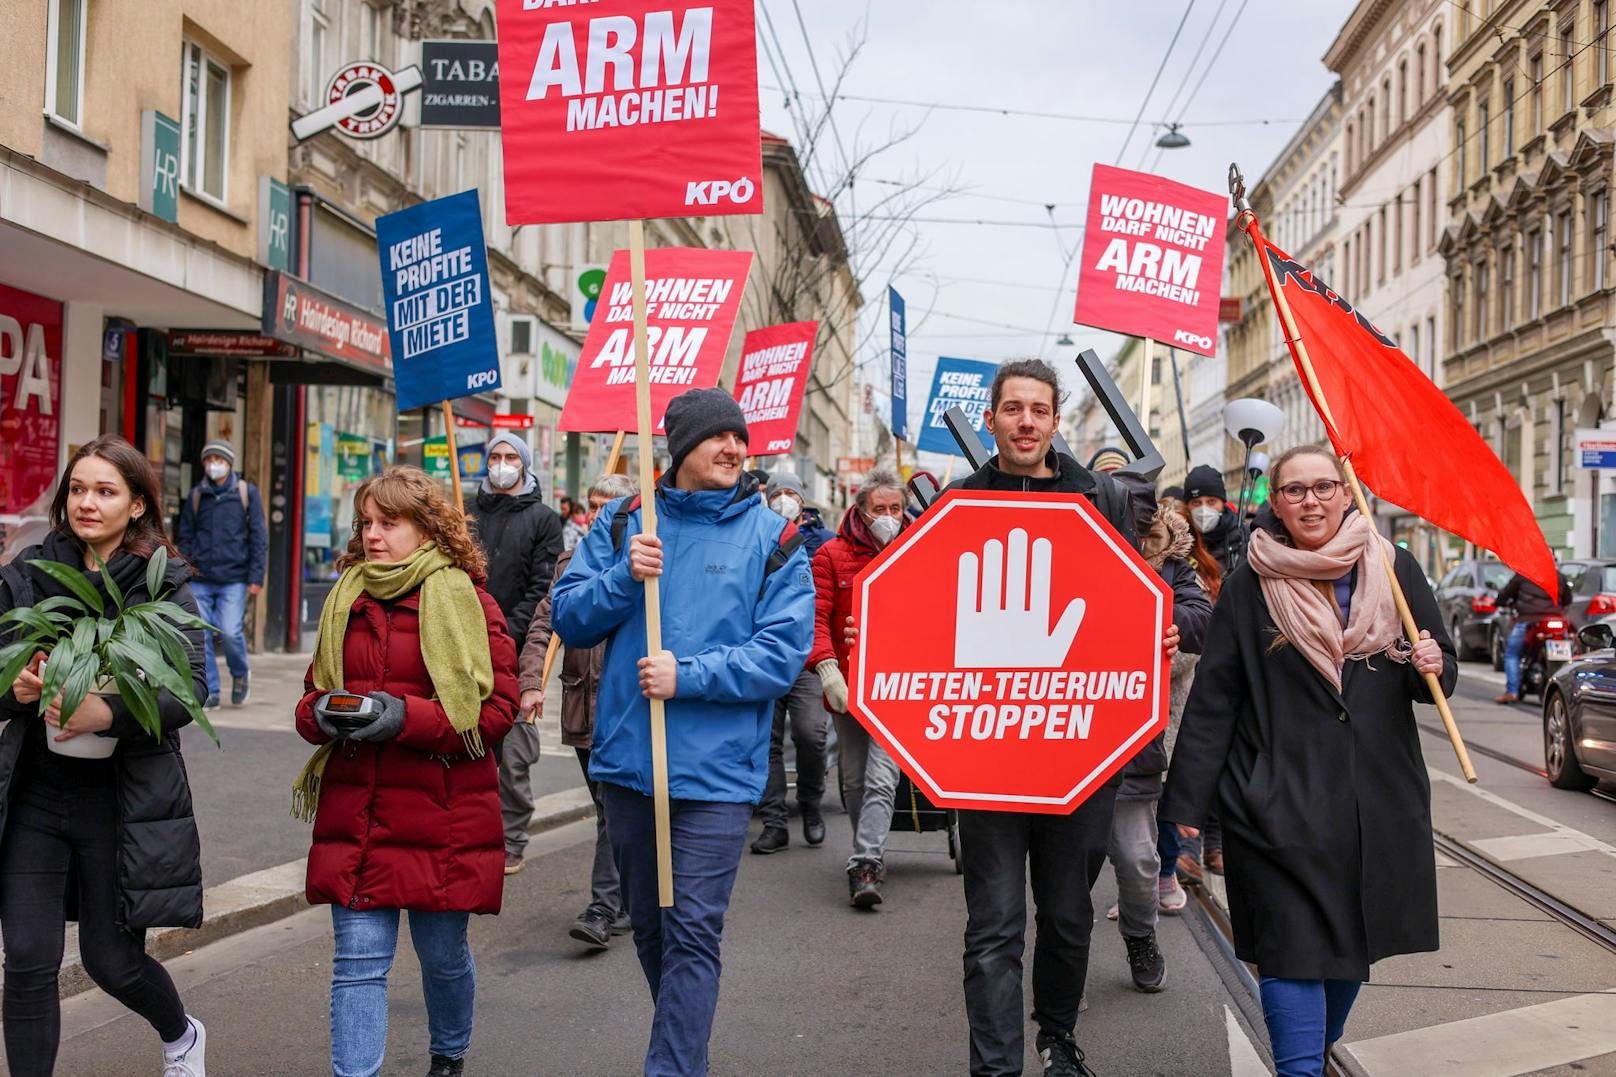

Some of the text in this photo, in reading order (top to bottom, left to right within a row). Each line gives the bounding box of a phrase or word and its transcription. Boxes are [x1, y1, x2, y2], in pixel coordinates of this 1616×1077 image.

[526, 7, 713, 101] ARM
[331, 66, 383, 100] TABAK
[424, 94, 489, 107] ZIGARREN
[348, 94, 397, 132] TRAFIK
[566, 85, 718, 132] MACHEN!
[153, 149, 177, 198] HR
[269, 210, 288, 251] HR
[1100, 194, 1217, 238] WOHNEN
[1101, 217, 1209, 251] DARF NICHT
[389, 228, 443, 272] KEINE
[1095, 238, 1203, 290] ARM
[396, 246, 472, 296] PROFITE
[399, 278, 477, 328] MIT DER
[1115, 274, 1200, 306] MACHEN!
[300, 298, 382, 355] Hairdesign Richard
[606, 303, 720, 322] DAF NICHT
[407, 313, 464, 355] MIETE
[590, 326, 708, 368] ARM
[743, 341, 808, 372] WOHNEN
[767, 359, 801, 376] NICHT
[606, 367, 698, 385] MAHEN!
[739, 376, 795, 412] ARM
[940, 371, 983, 386] KEINE
[965, 402, 992, 415] DE
[871, 671, 1147, 701] MIETEN-TEUERUNG
[925, 704, 1095, 740] STOPPEN
